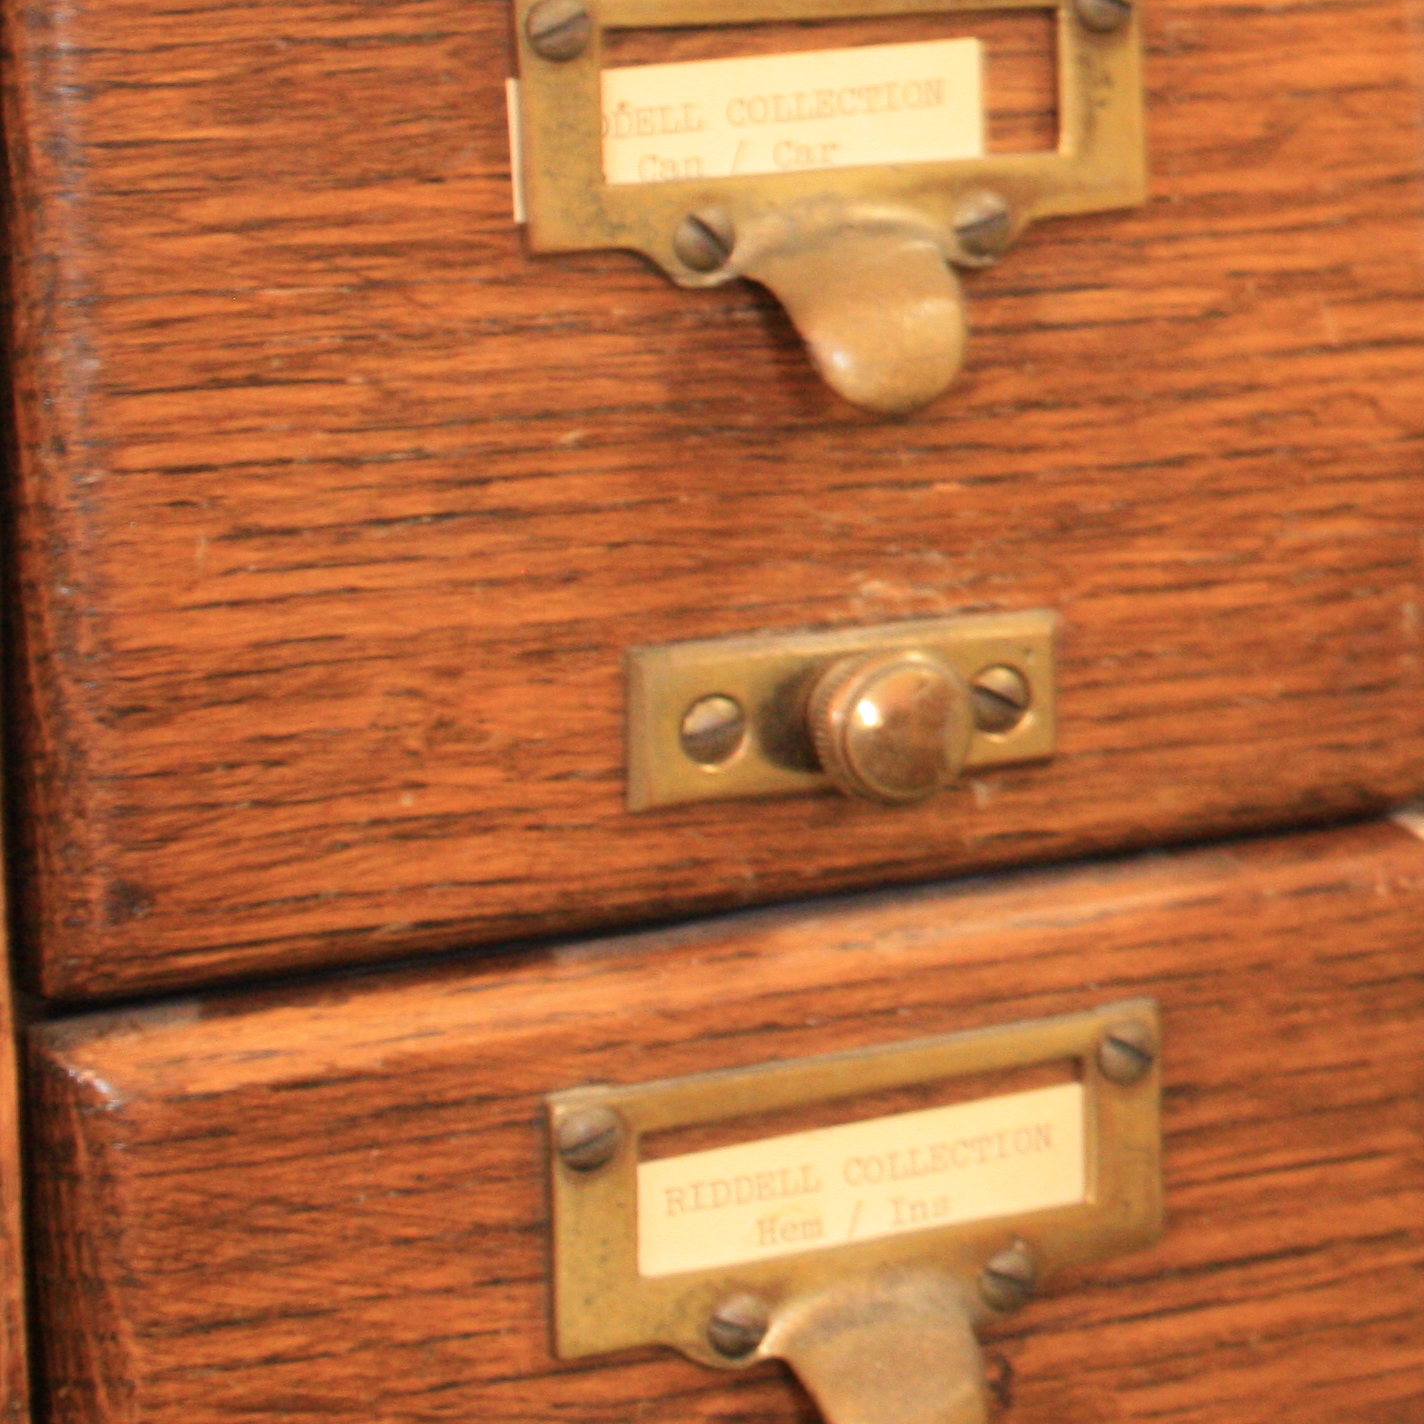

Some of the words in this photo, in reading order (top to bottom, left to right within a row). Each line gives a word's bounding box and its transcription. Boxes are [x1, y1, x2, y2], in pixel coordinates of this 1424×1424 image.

[725, 78, 944, 127] COLLECTION
[637, 152, 705, 183] Can
[771, 138, 841, 171] Car
[664, 1165, 822, 1217] RIDDELL
[843, 1123, 1053, 1187] COLLECTION
[755, 1214, 825, 1249] Hem
[889, 1191, 952, 1228] Ins
